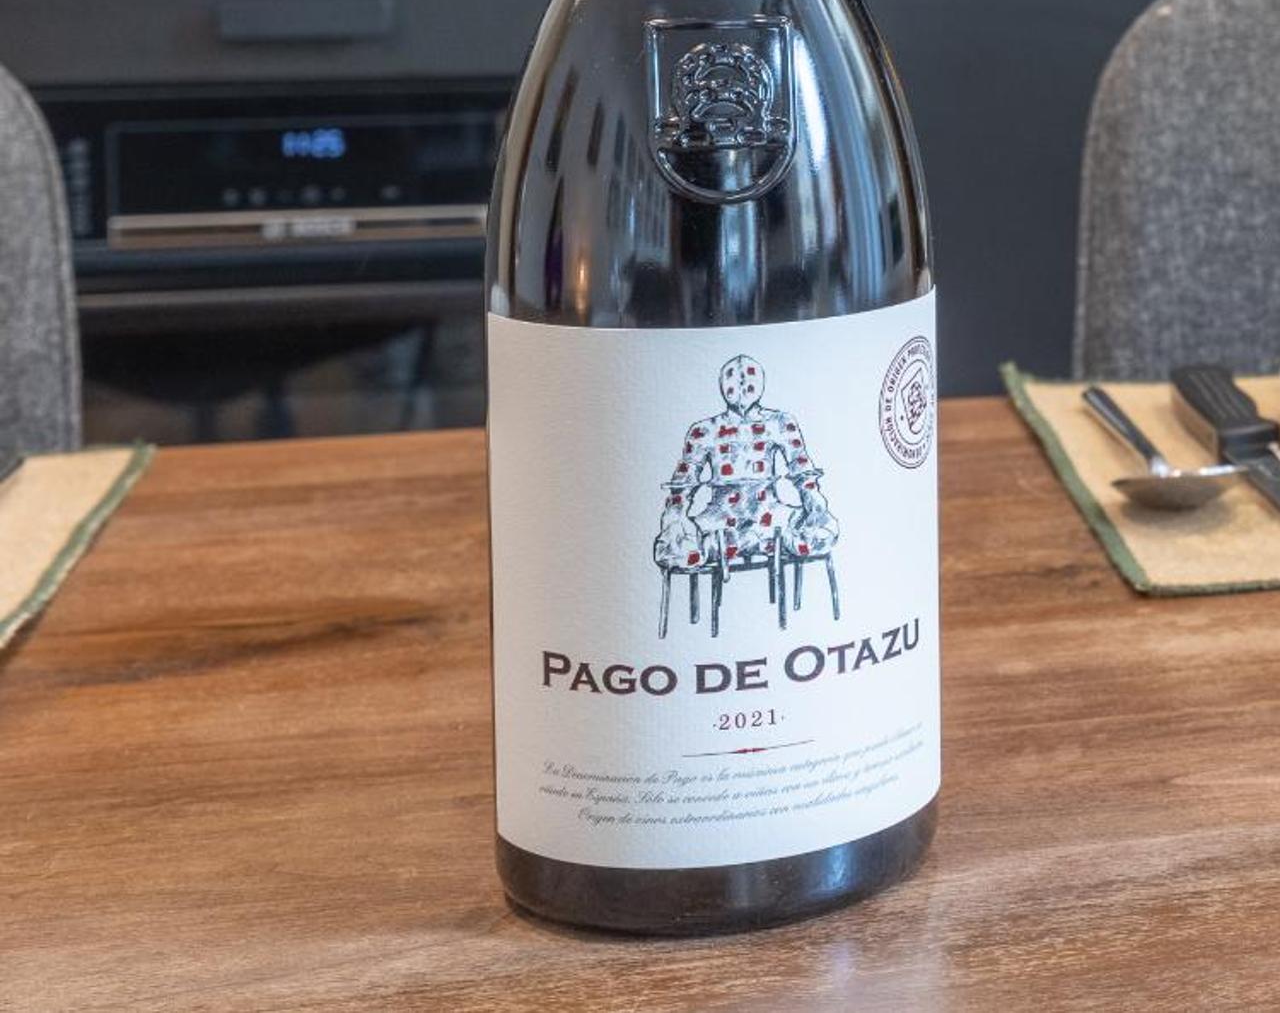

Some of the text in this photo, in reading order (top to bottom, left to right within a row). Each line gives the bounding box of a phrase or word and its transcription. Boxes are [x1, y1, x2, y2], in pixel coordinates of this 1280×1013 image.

[541, 617, 921, 697] PAGO DE OTAZU
